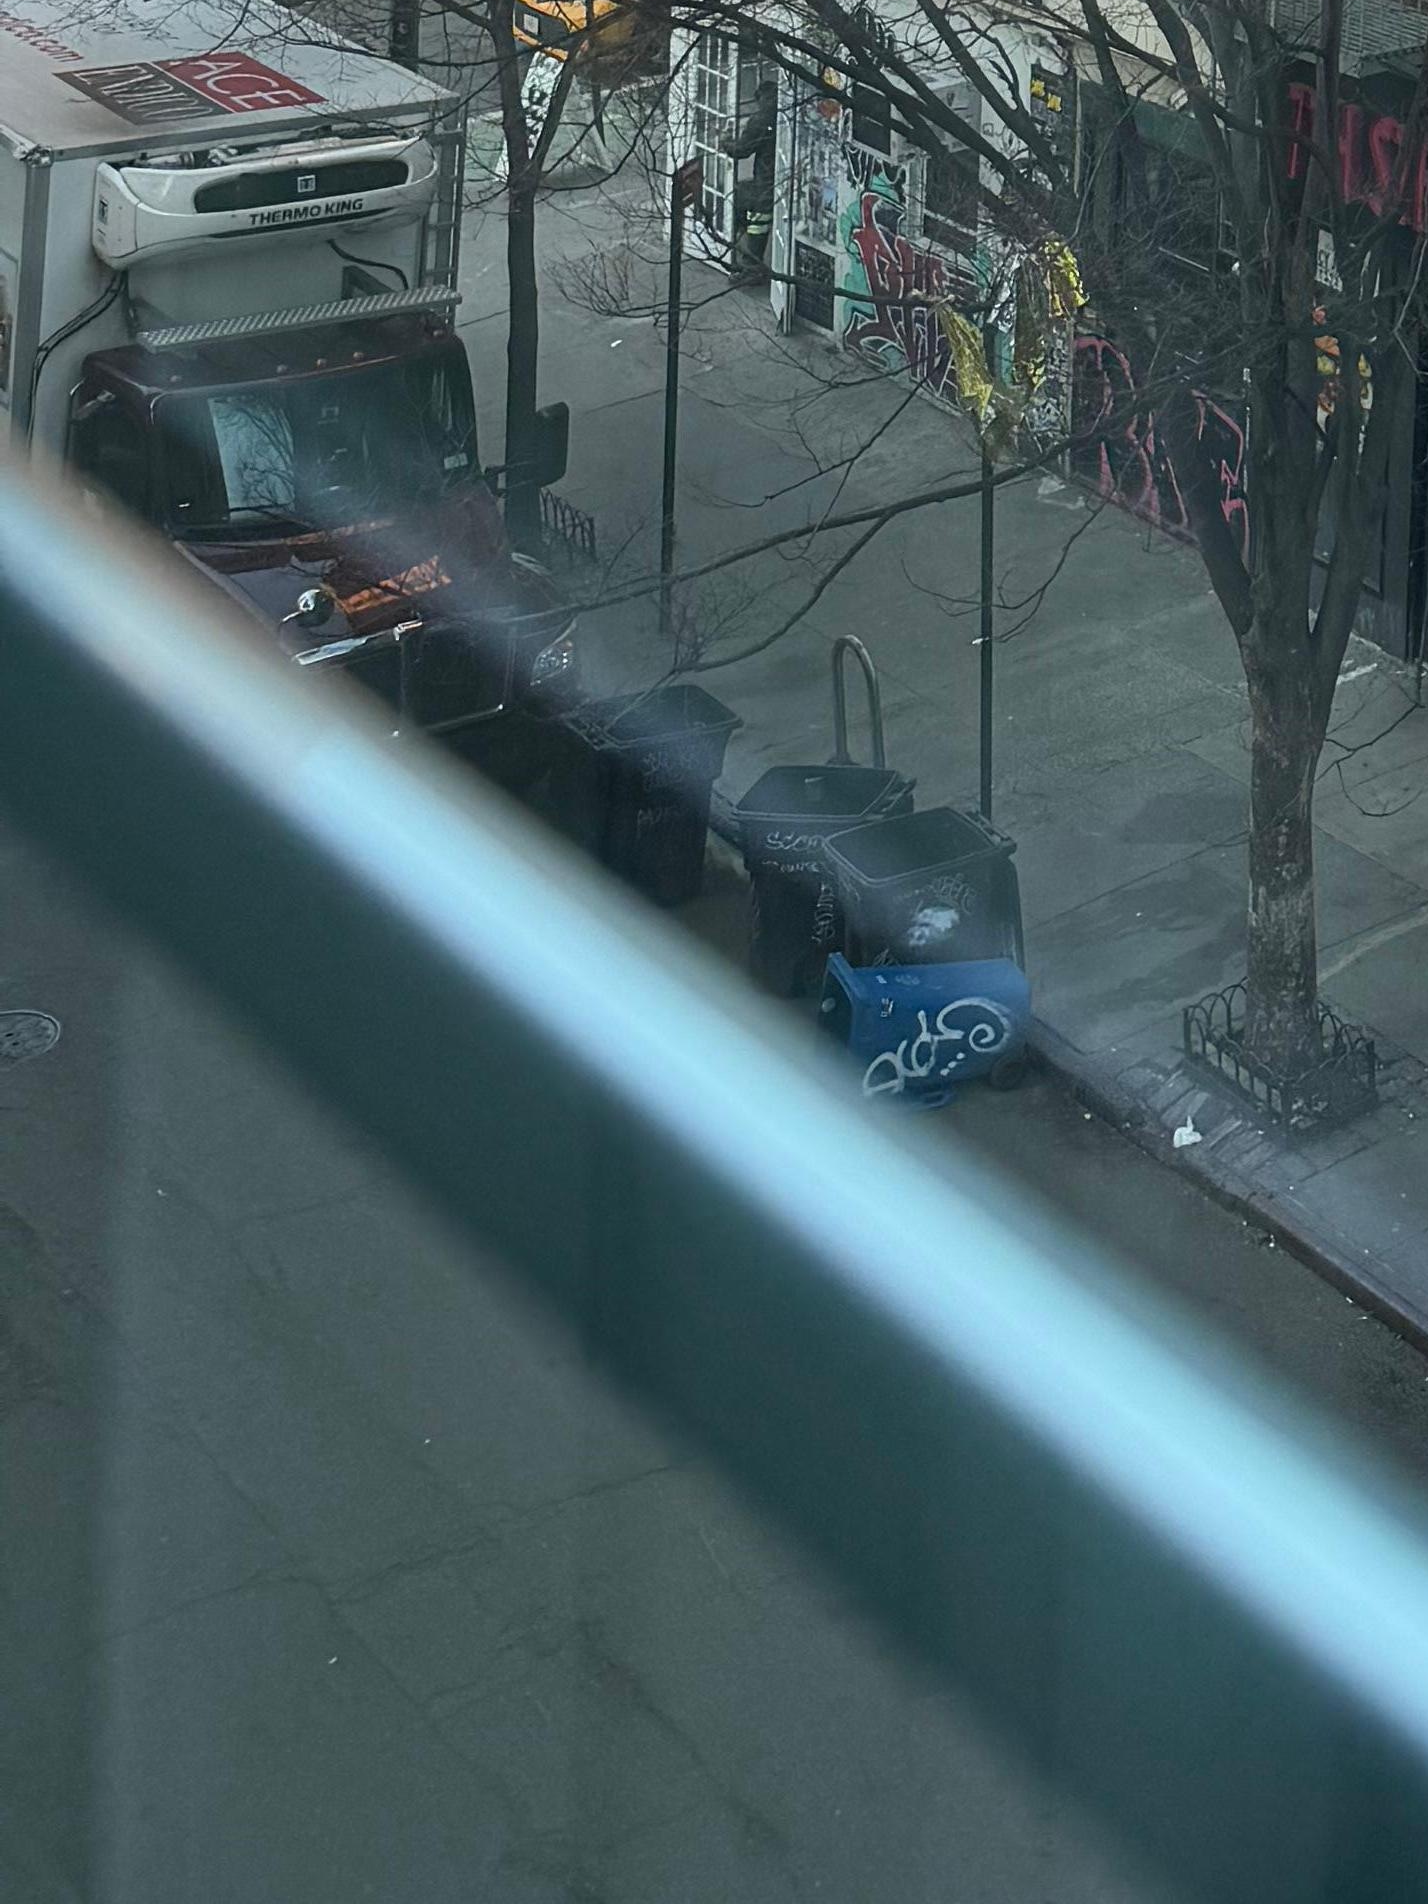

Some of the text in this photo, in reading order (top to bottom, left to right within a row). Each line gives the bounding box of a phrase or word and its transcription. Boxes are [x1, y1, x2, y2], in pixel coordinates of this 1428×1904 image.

[171, 59, 306, 110] ACE
[250, 197, 364, 227] THERMO KING
